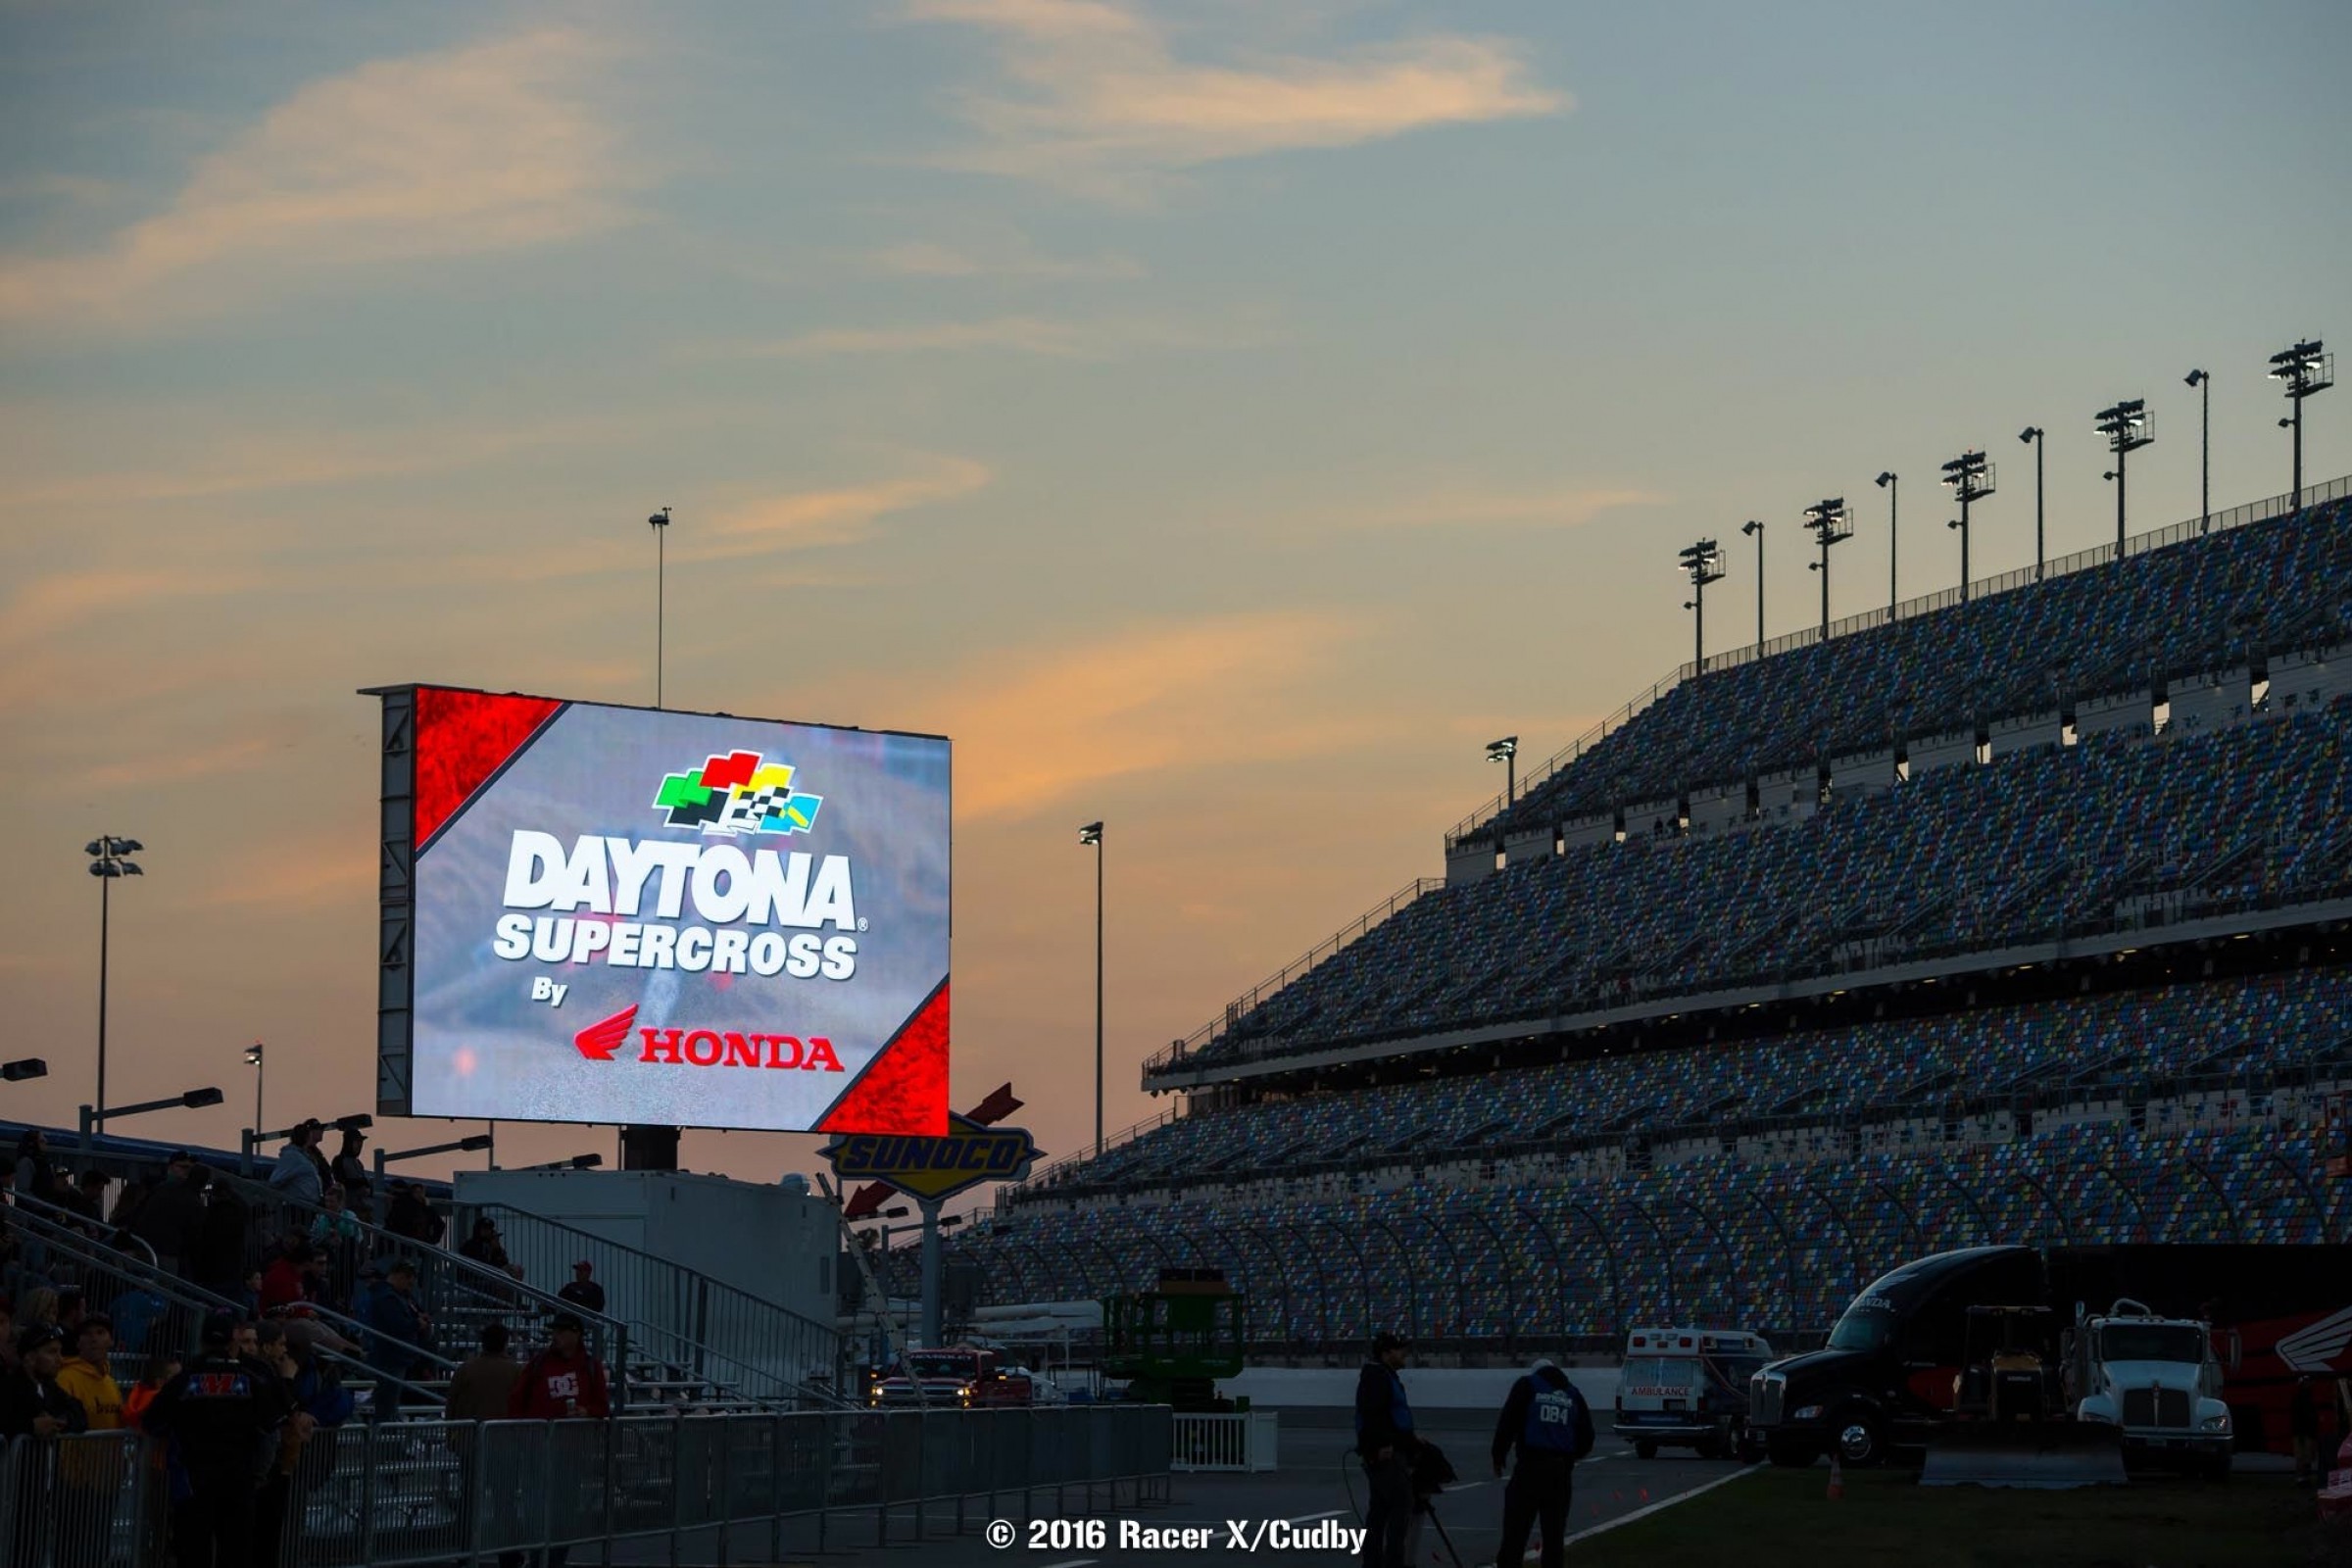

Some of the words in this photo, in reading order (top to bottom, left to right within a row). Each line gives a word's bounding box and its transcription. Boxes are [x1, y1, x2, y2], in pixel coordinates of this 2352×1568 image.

[493, 913, 858, 980] SUPERCROSS
[531, 976, 568, 1007] By
[639, 1028, 845, 1072] HONDA
[843, 1138, 1020, 1170] SUNOCO
[1631, 1387, 1690, 1396] AMBULANCE
